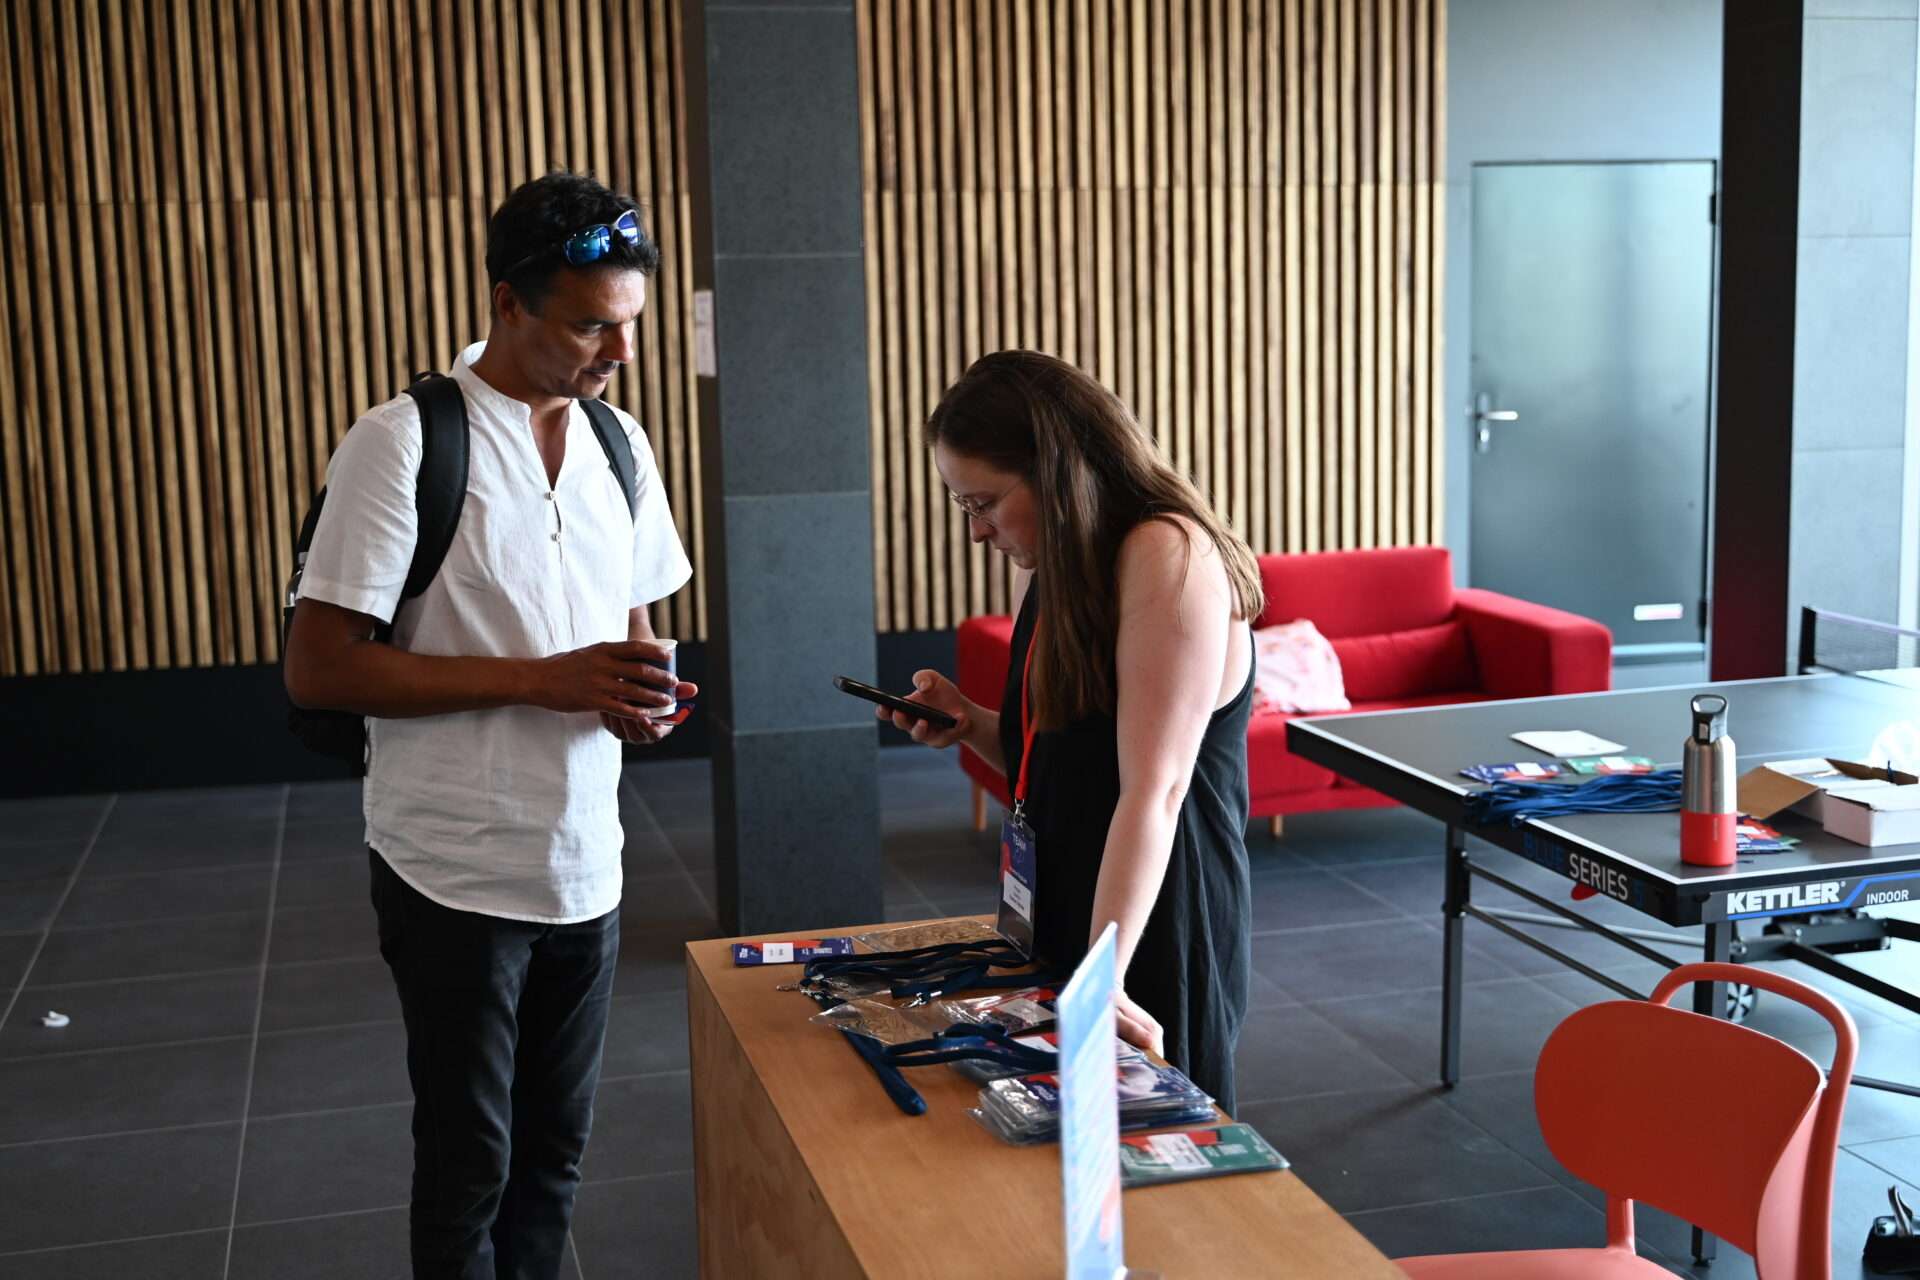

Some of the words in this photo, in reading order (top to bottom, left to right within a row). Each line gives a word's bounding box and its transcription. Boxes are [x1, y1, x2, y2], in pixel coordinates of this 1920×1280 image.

[1569, 853, 1629, 901] SERIES
[1727, 881, 1841, 914] KETTLER
[1866, 889, 1910, 905] INDOOR
